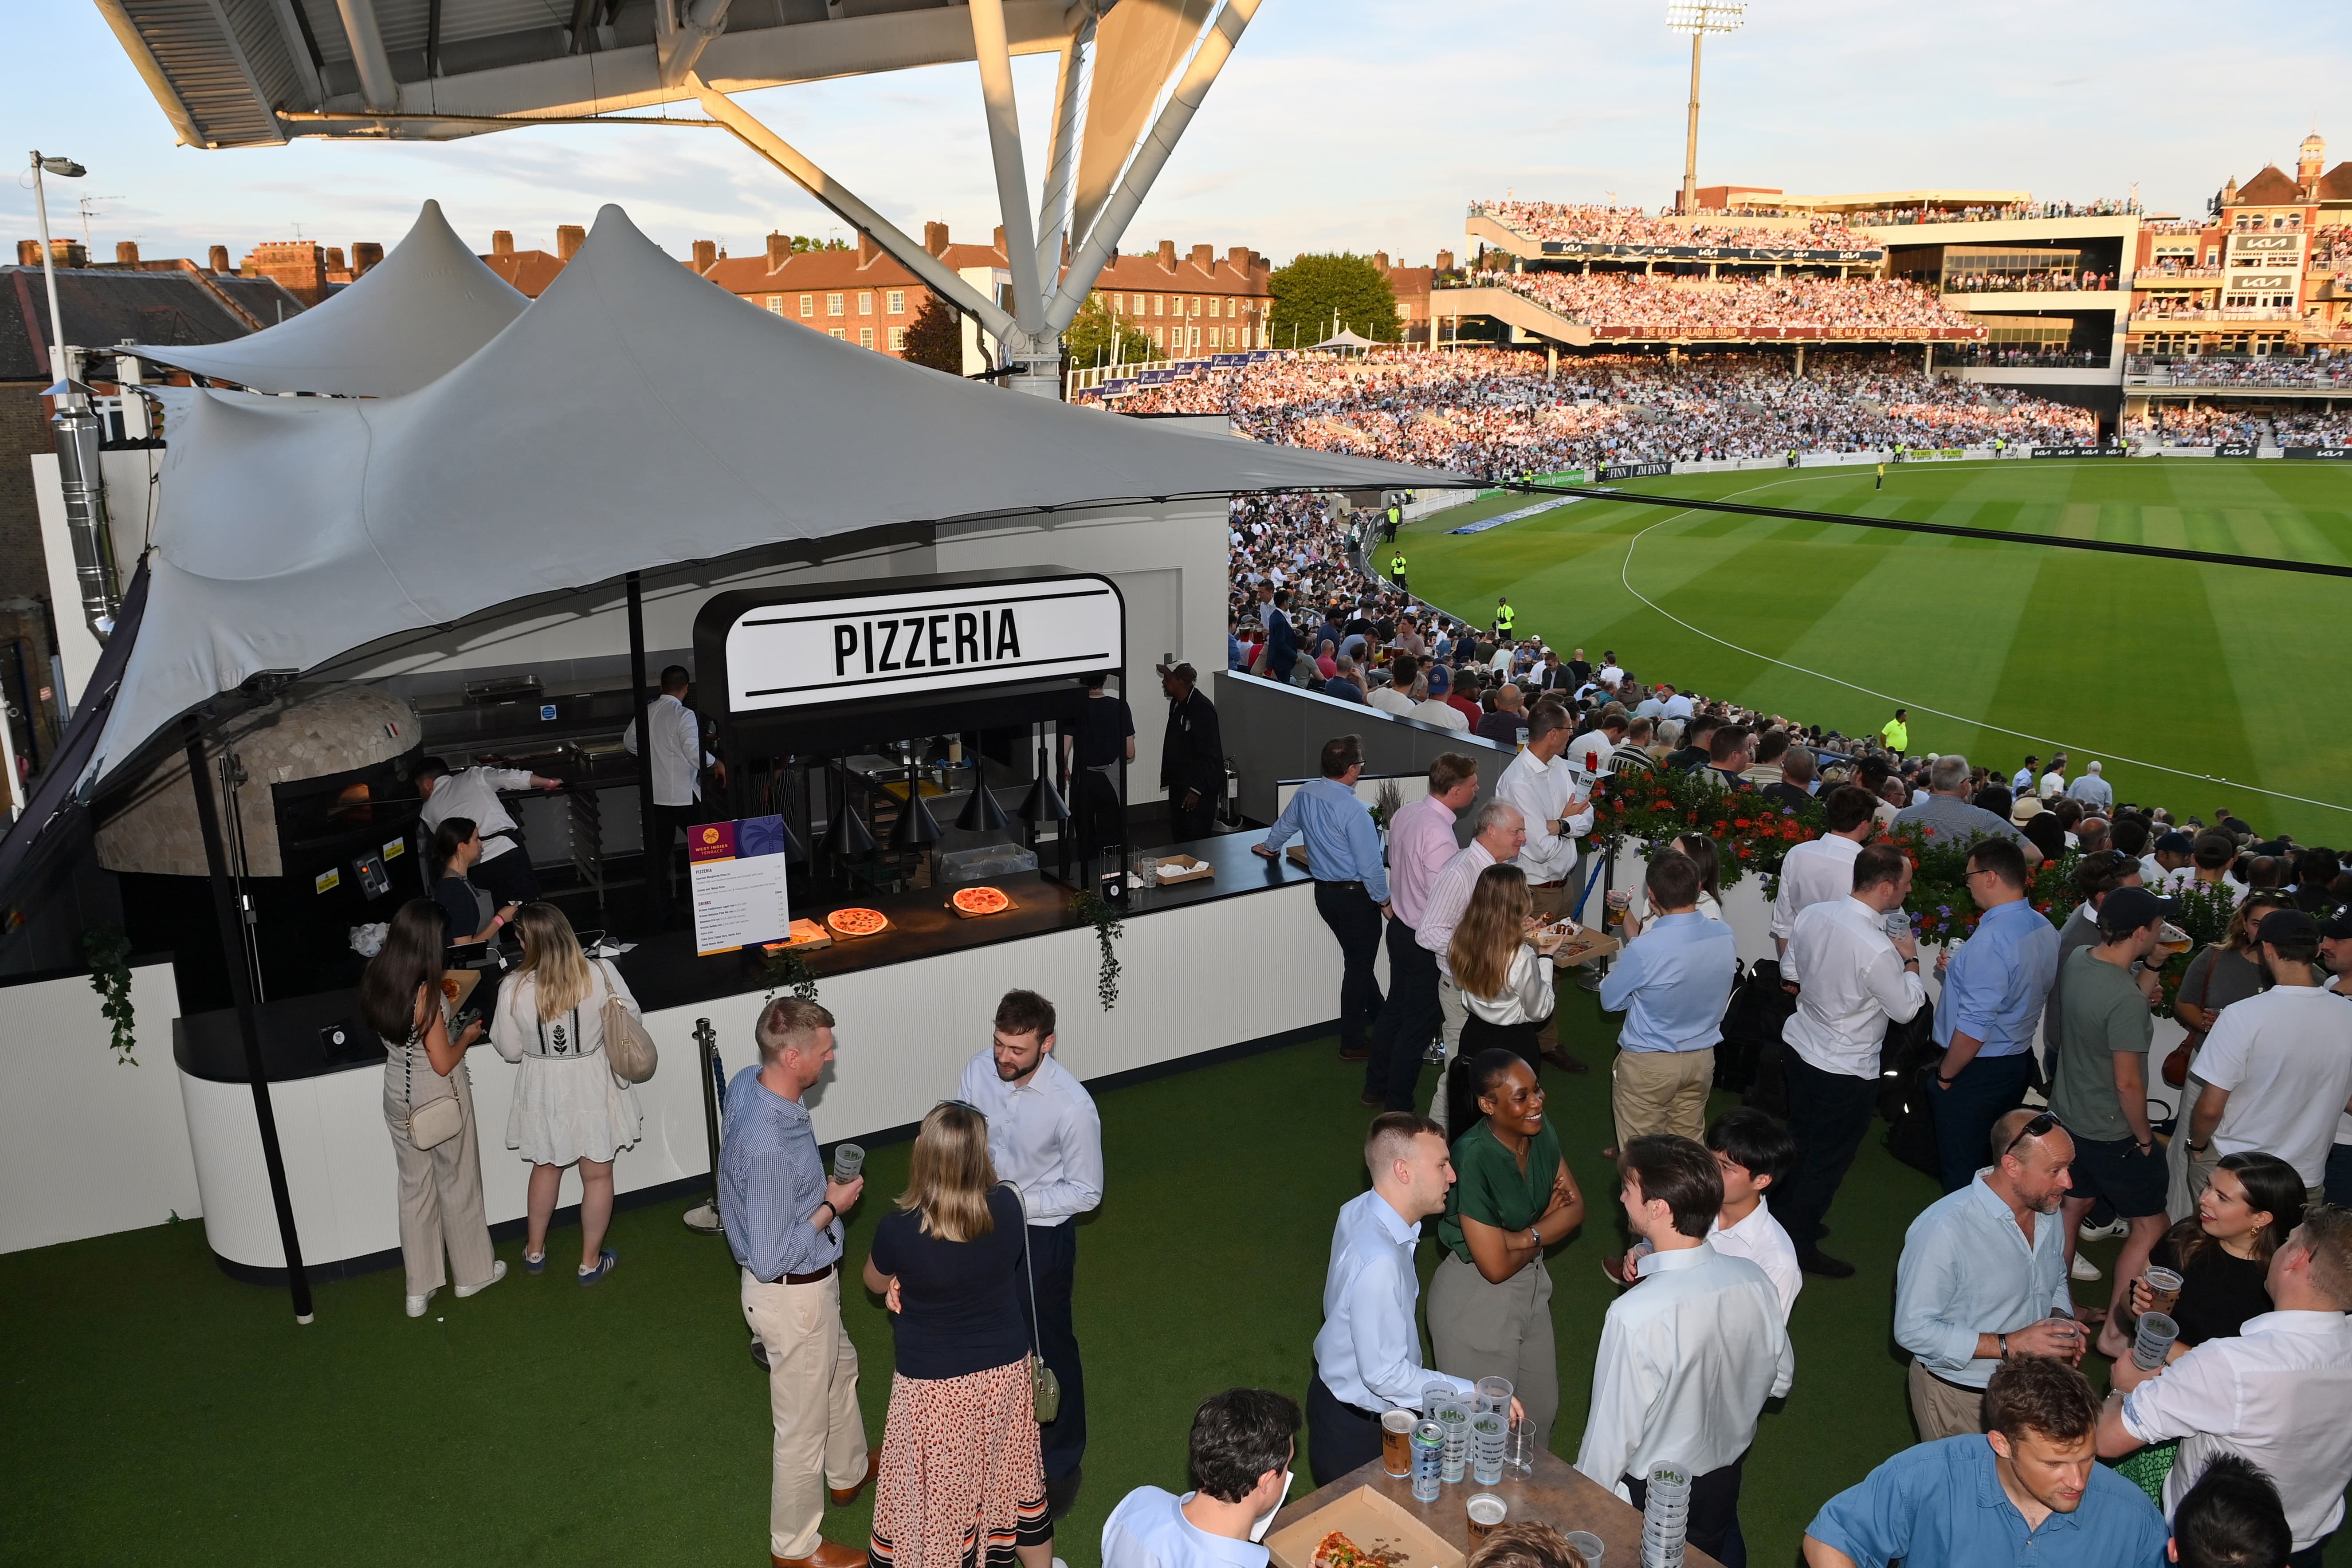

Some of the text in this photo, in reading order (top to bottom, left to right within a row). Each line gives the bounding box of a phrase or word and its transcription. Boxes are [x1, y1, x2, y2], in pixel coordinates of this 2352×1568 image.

[2247, 238, 2287, 248] KIA
[2242, 277, 2282, 287] KIA
[1642, 327, 1737, 336] THE M.A.R. GALADARI STAND
[1830, 328, 1930, 337] THE M.A.R. GALADARI STAND
[1610, 467, 1627, 478] FINN
[1636, 464, 1667, 476] JM FINN
[834, 608, 1021, 677] PIZZERIA
